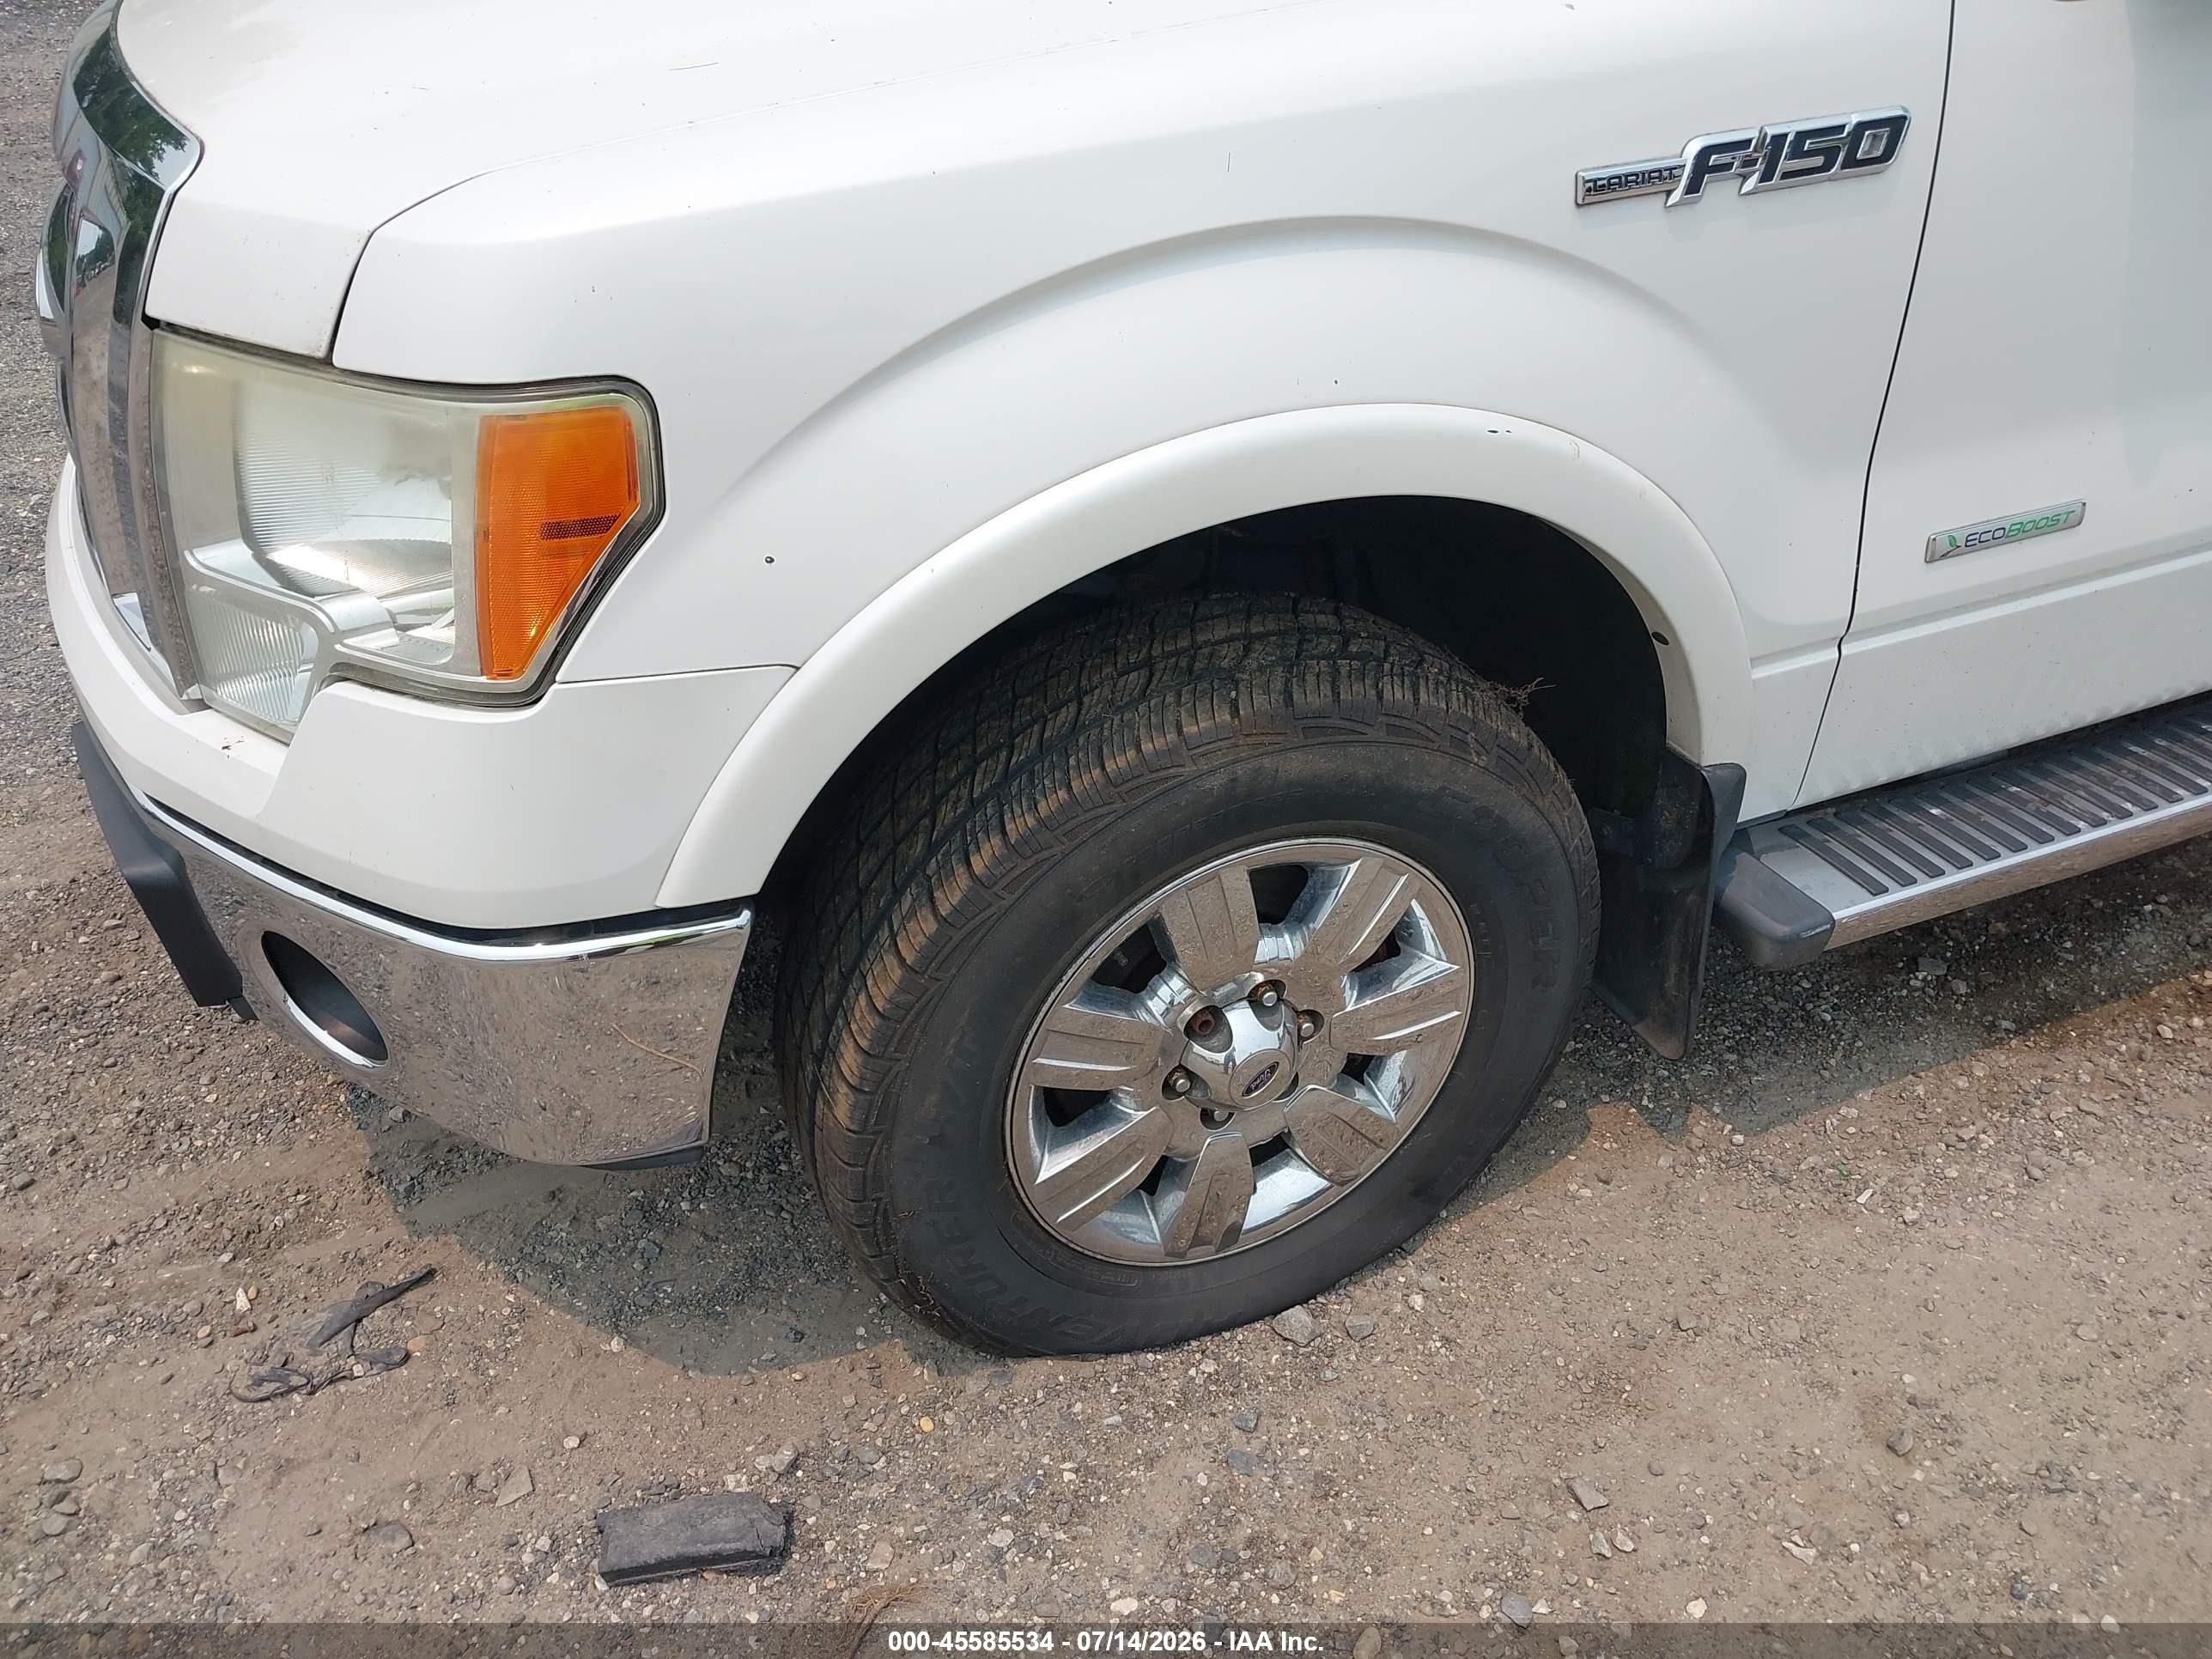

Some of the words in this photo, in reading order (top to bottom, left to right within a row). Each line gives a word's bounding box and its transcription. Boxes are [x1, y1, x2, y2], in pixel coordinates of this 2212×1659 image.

[1591, 166, 1679, 194] LARIAT
[1665, 106, 1911, 208] F-150
[1250, 1069, 1271, 1091] Ford
